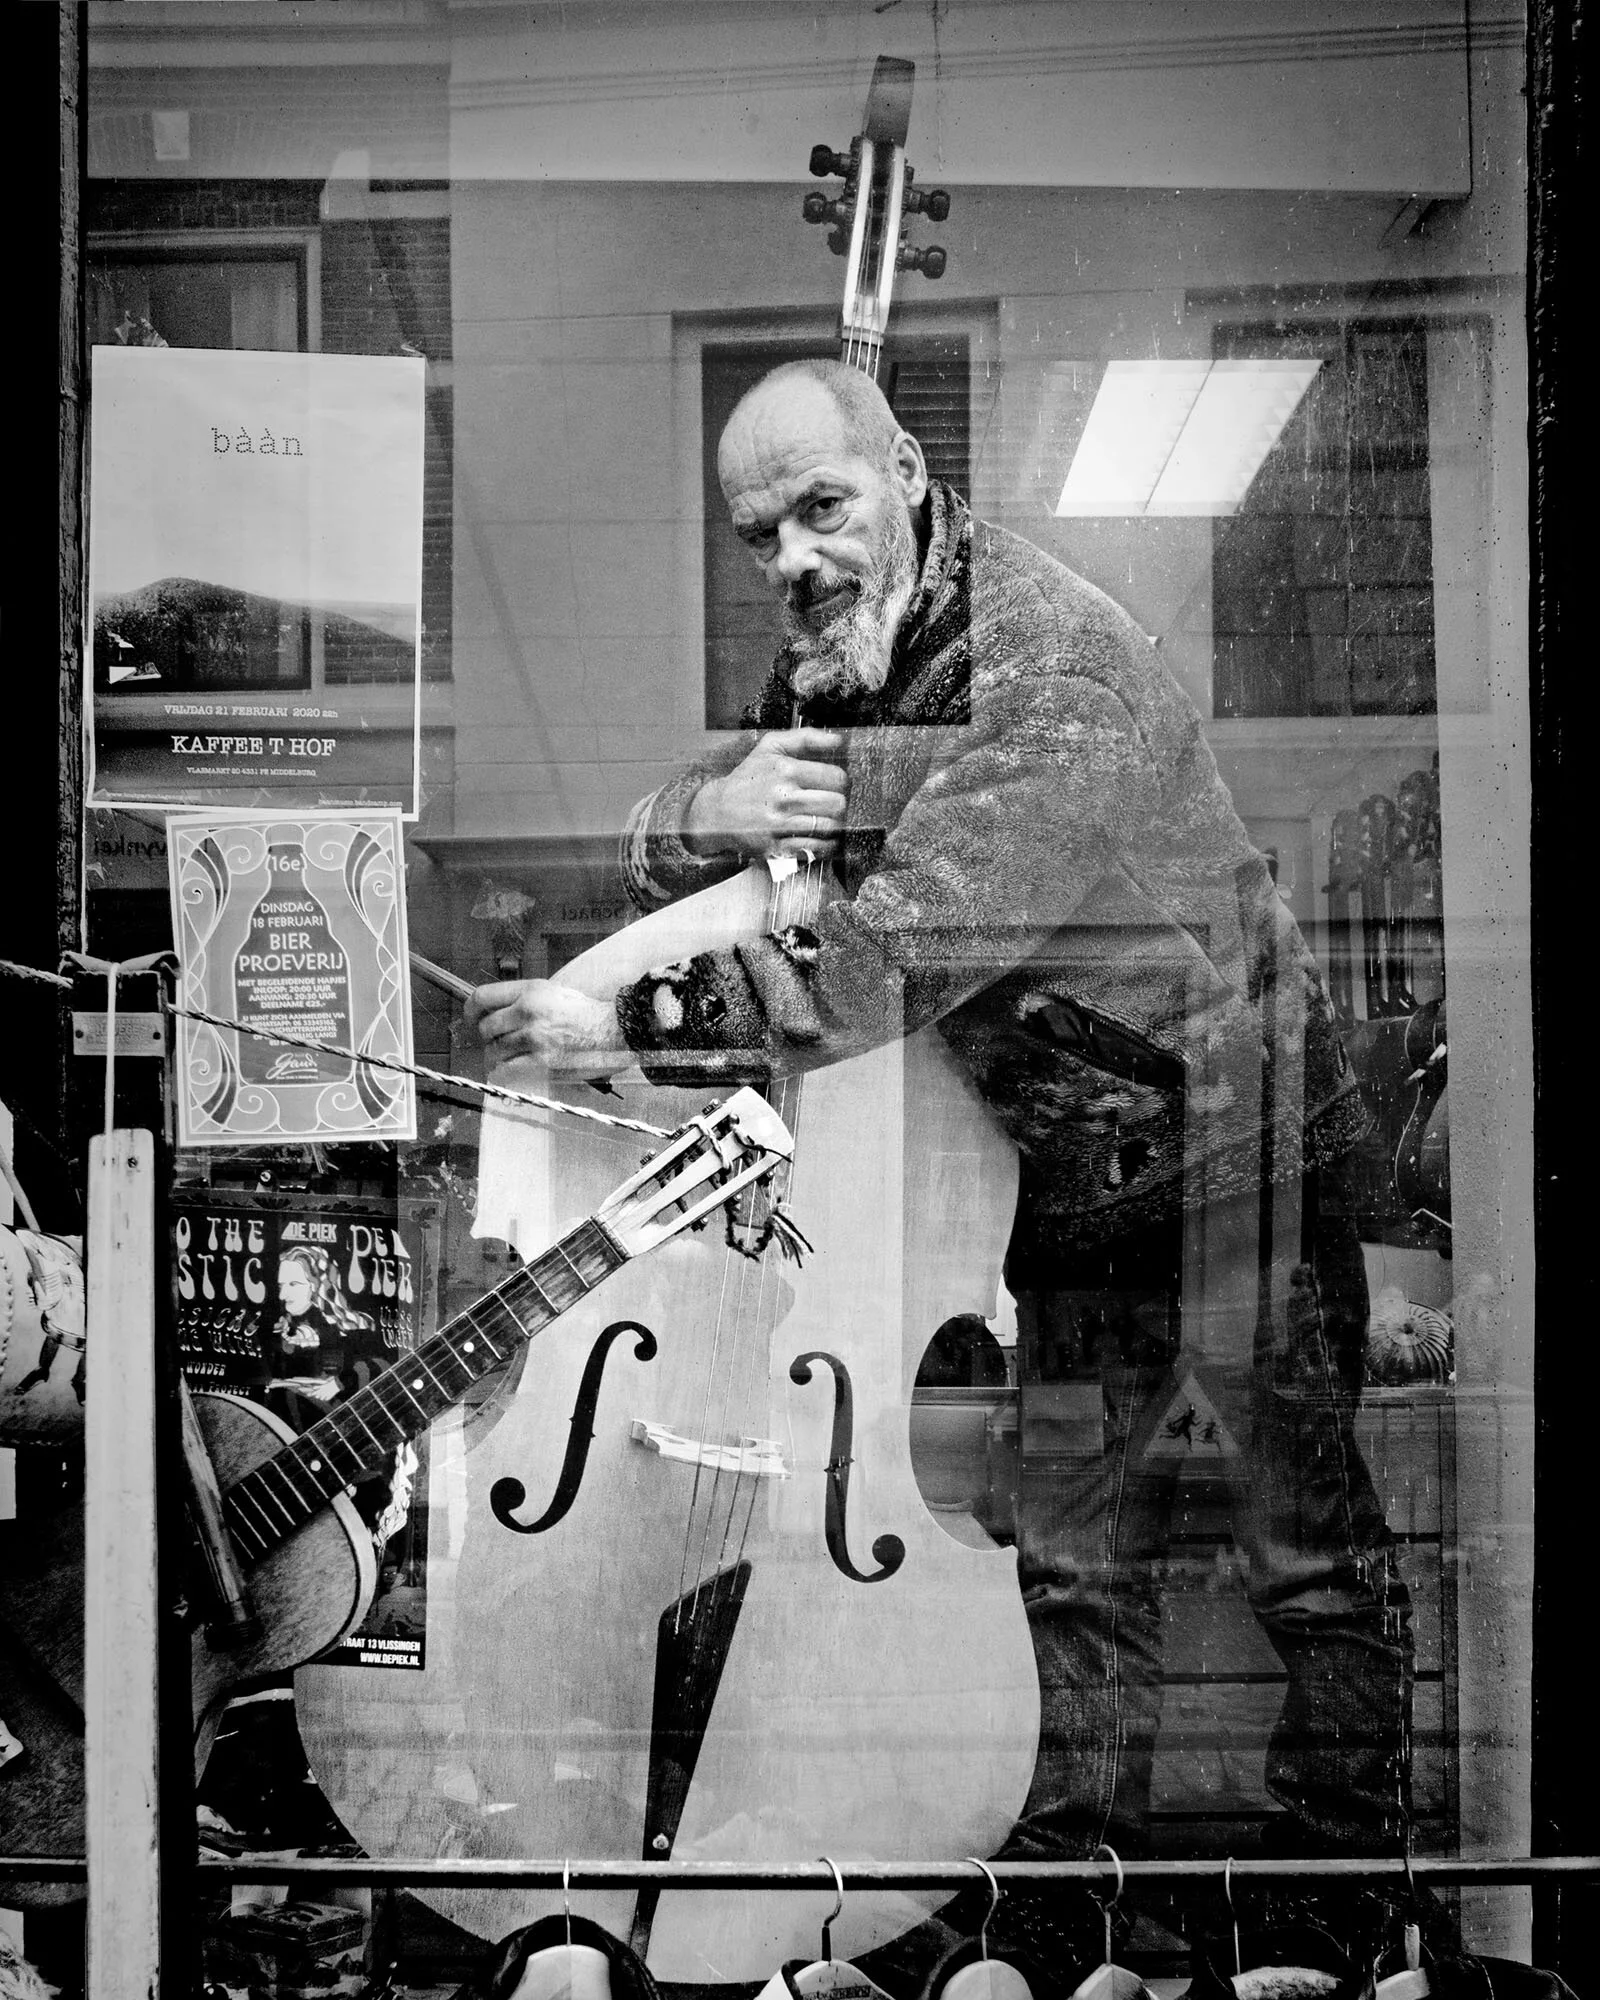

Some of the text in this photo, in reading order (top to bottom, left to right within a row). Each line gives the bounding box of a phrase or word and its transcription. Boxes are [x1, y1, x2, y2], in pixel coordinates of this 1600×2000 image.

[211, 427, 303, 455] bààn
[164, 705, 213, 716] VRIJDAG
[216, 705, 228, 716] 21
[232, 706, 288, 717] FEBRUARI
[293, 708, 320, 718] 2020
[171, 735, 336, 756] KAFFEE T HOF
[187, 767, 231, 775] VLASMARKT
[242, 768, 258, 776] 4331
[270, 768, 317, 777] MIDDELBURG
[271, 855, 301, 871] 16e
[261, 902, 314, 914] DINSDAG
[253, 915, 323, 929] 18 FEBRUARI
[269, 932, 312, 950] BIER
[239, 953, 343, 972] PROEVERIJ
[238, 976, 346, 987] MET BEGELEIDENDE HAPJES
[253, 986, 287, 994] INLOOP:
[289, 985, 312, 993] 20:00
[248, 993, 293, 1002] AANVANG:
[318, 992, 337, 1000] UUR
[261, 1000, 304, 1009] DEELNAME
[314, 1031, 337, 1039] LANGS
[206, 1216, 265, 1254] THE
[284, 1222, 337, 1243] DE PIEK
[178, 1253, 266, 1304] STIC
[186, 1361, 226, 1376] WONDER
[209, 1381, 251, 1396] PROJECT
[368, 1638, 377, 1649] 13
[378, 1639, 421, 1652] VLISSINGEN
[360, 1652, 420, 1666] WWW.DEPIEK.NL
